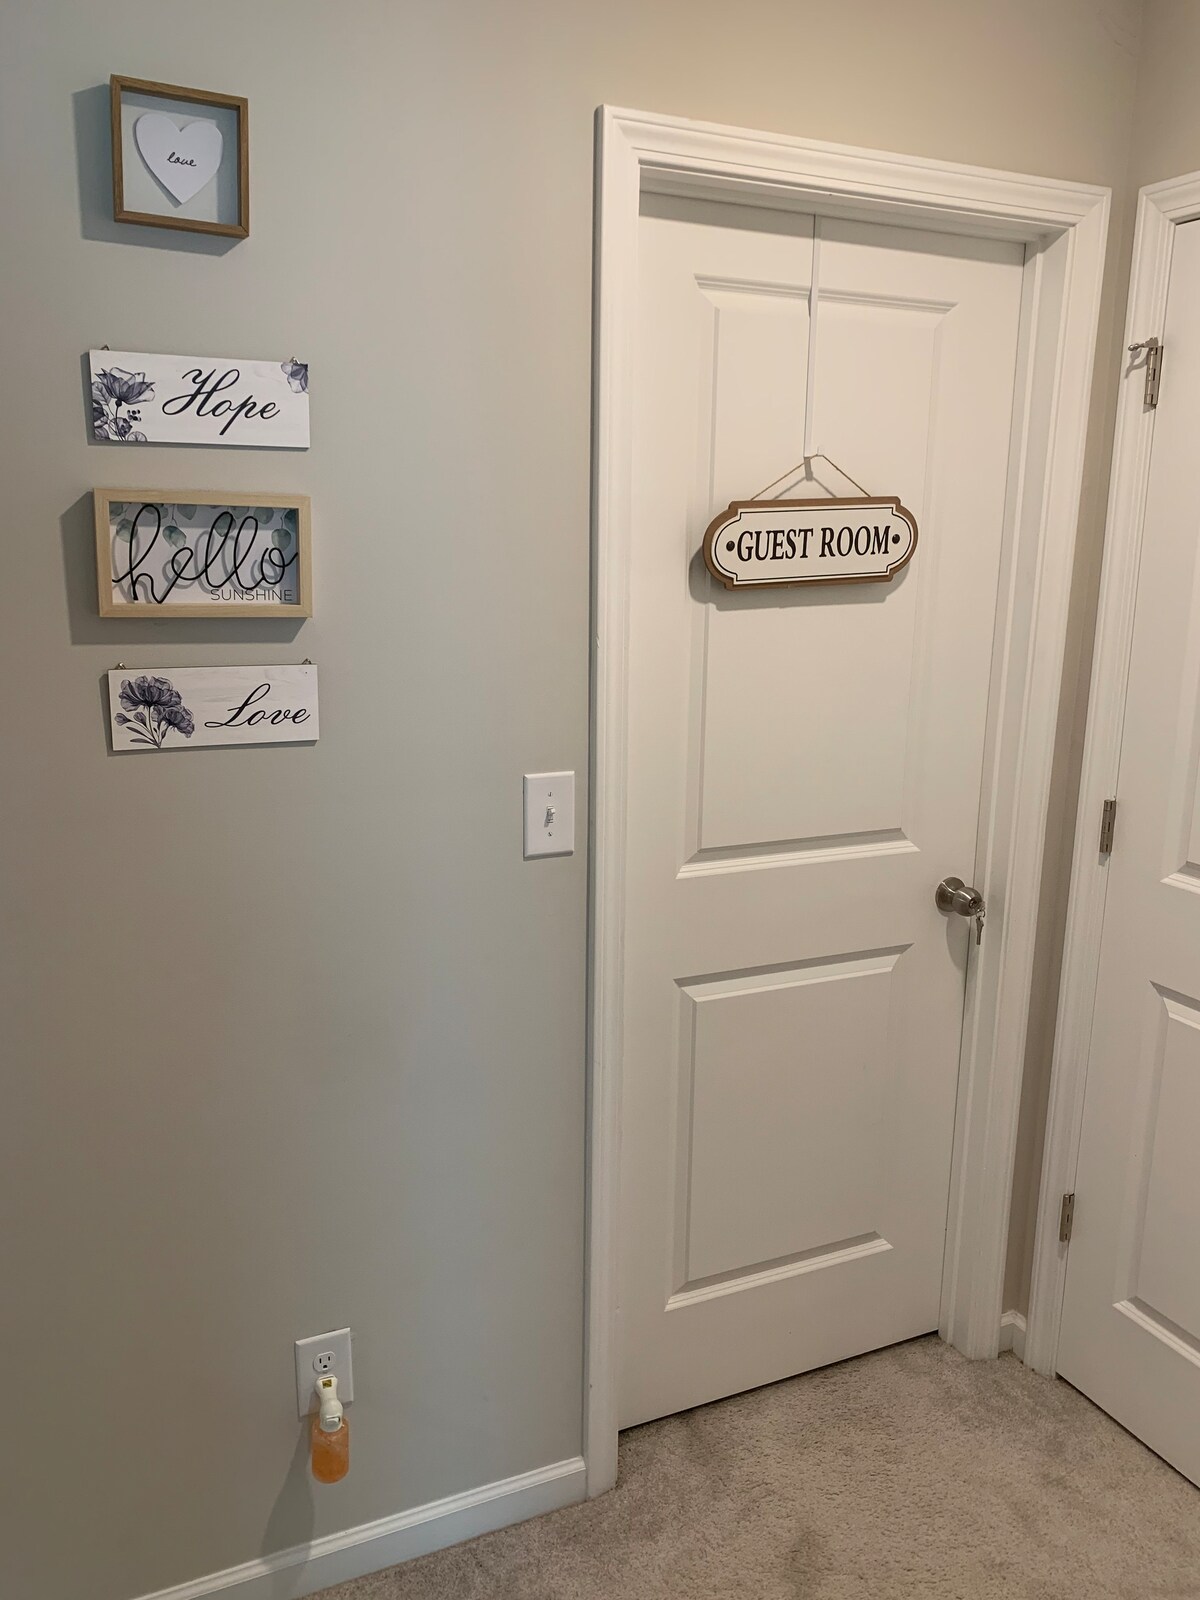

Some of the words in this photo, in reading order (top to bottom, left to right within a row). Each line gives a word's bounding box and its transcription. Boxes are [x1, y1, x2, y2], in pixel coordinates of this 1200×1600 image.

[167, 151, 197, 167] love
[162, 368, 280, 435] Hope
[112, 504, 299, 604] hello
[737, 528, 814, 562] GUEST
[819, 525, 891, 558] ROOM
[210, 588, 293, 602] SUNSHINE
[204, 683, 311, 728] Love
